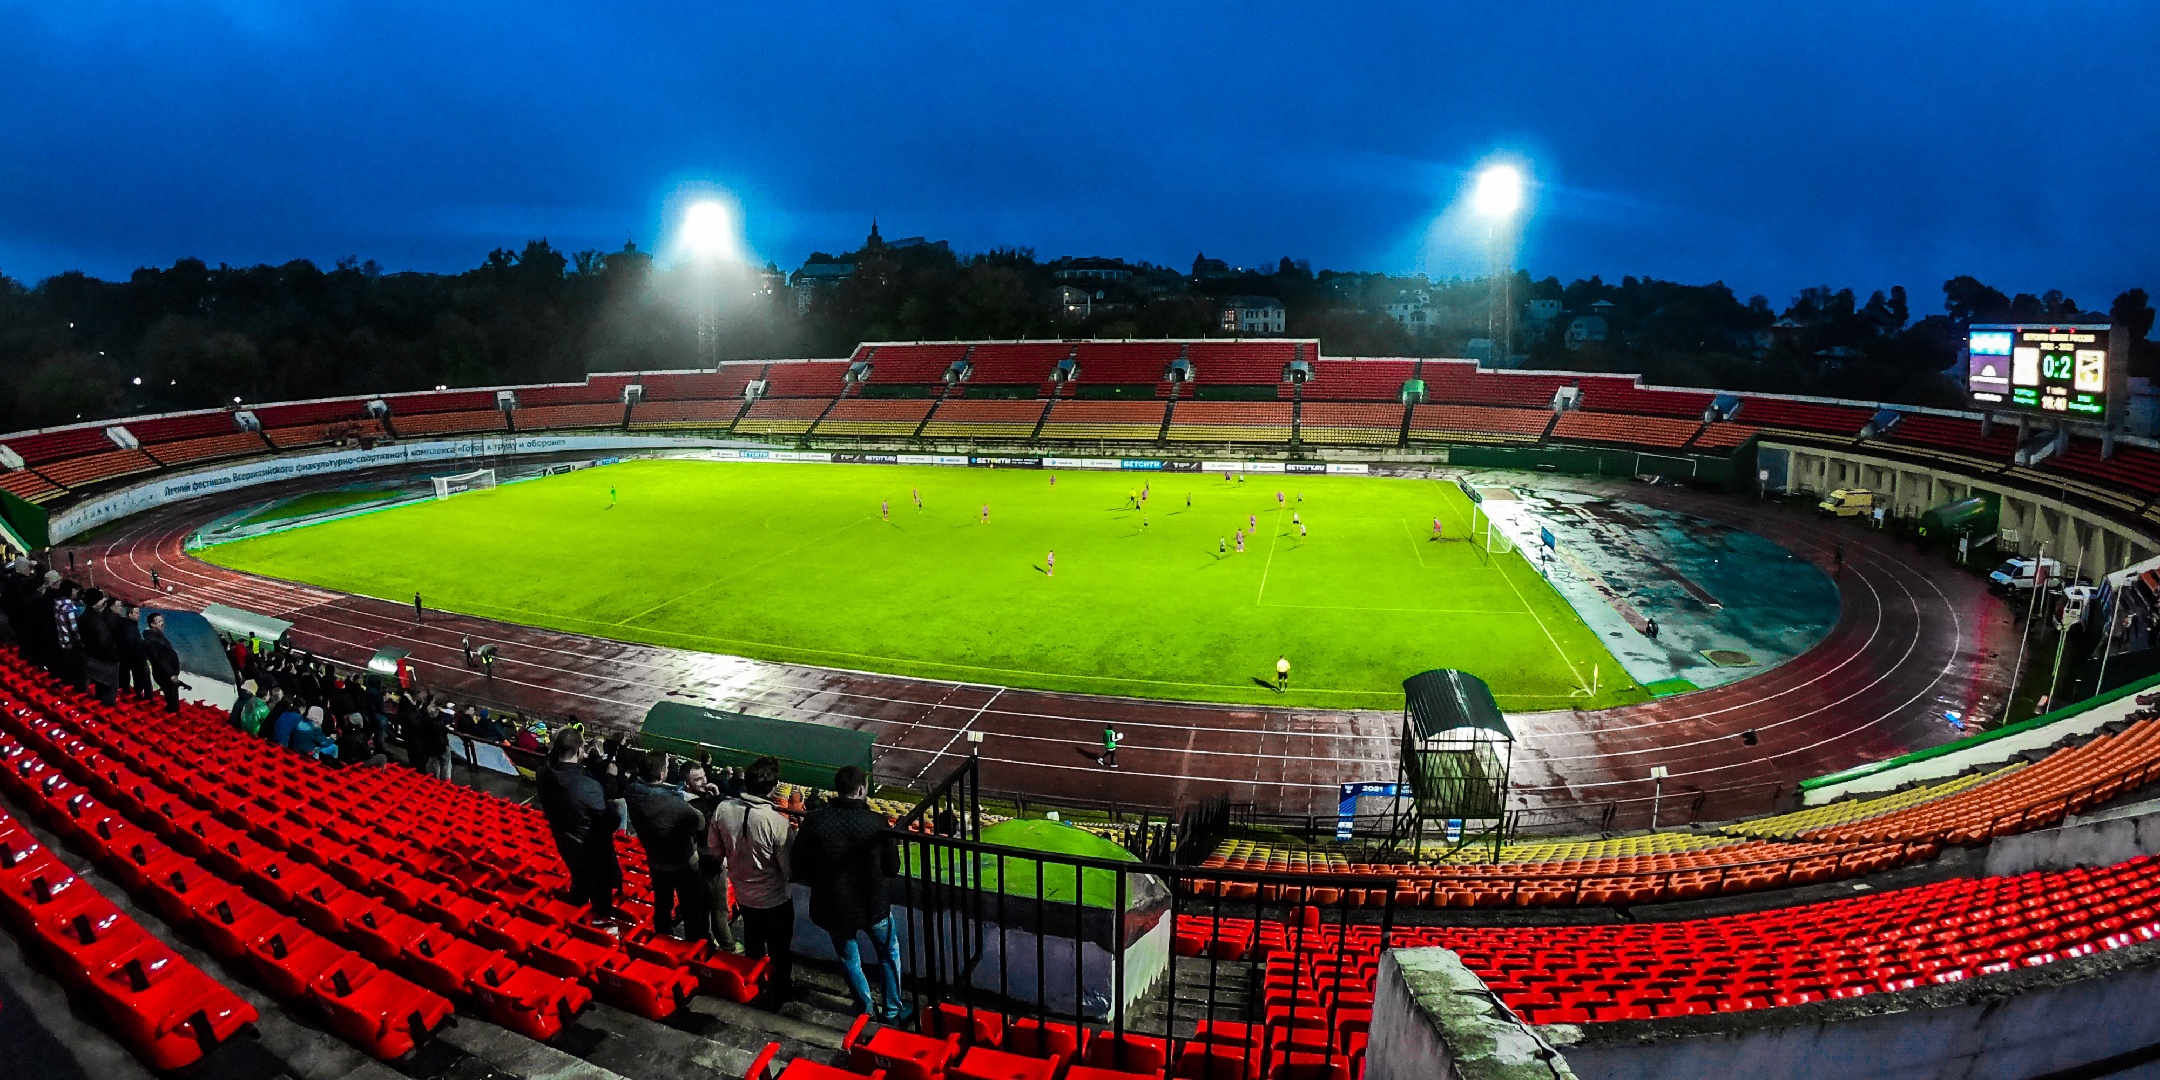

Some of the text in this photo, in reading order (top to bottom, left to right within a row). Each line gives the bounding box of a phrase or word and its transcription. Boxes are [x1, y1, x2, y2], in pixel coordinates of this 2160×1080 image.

[2043, 355, 2071, 379] 0:2
[165, 482, 191, 497] Летний
[192, 476, 231, 492] фестиваль
[233, 466, 294, 482] Всероссийского
[296, 452, 409, 473] физкультурно-спортивного
[411, 446, 455, 457] комплекса
[493, 442, 517, 452] труду
[527, 438, 566, 449] обороне»
[1123, 460, 1160, 468] БЕТСИТИ
